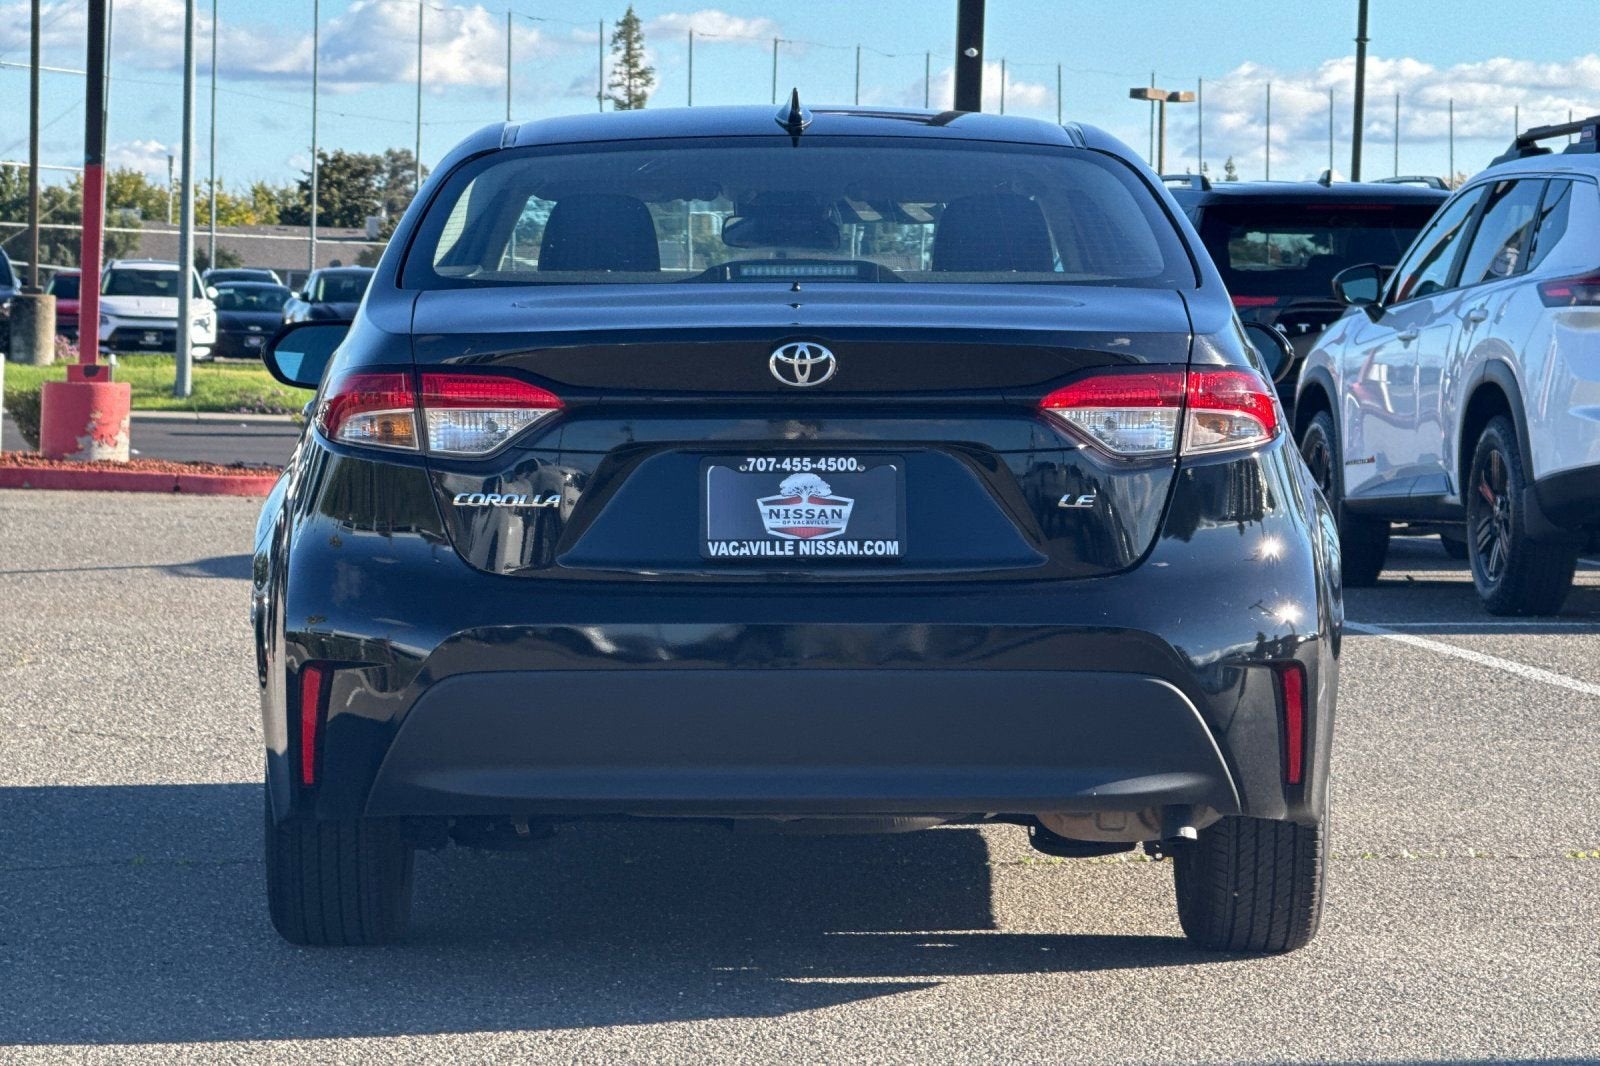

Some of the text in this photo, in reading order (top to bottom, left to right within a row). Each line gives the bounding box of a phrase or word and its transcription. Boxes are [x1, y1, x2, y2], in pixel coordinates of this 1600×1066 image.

[747, 457, 858, 472] 707-455-4500
[453, 493, 561, 507] COROLLA
[1058, 494, 1096, 507] LE
[768, 508, 843, 519] NISSAN
[708, 541, 900, 556] VACAVILLE NISSAN.COM
